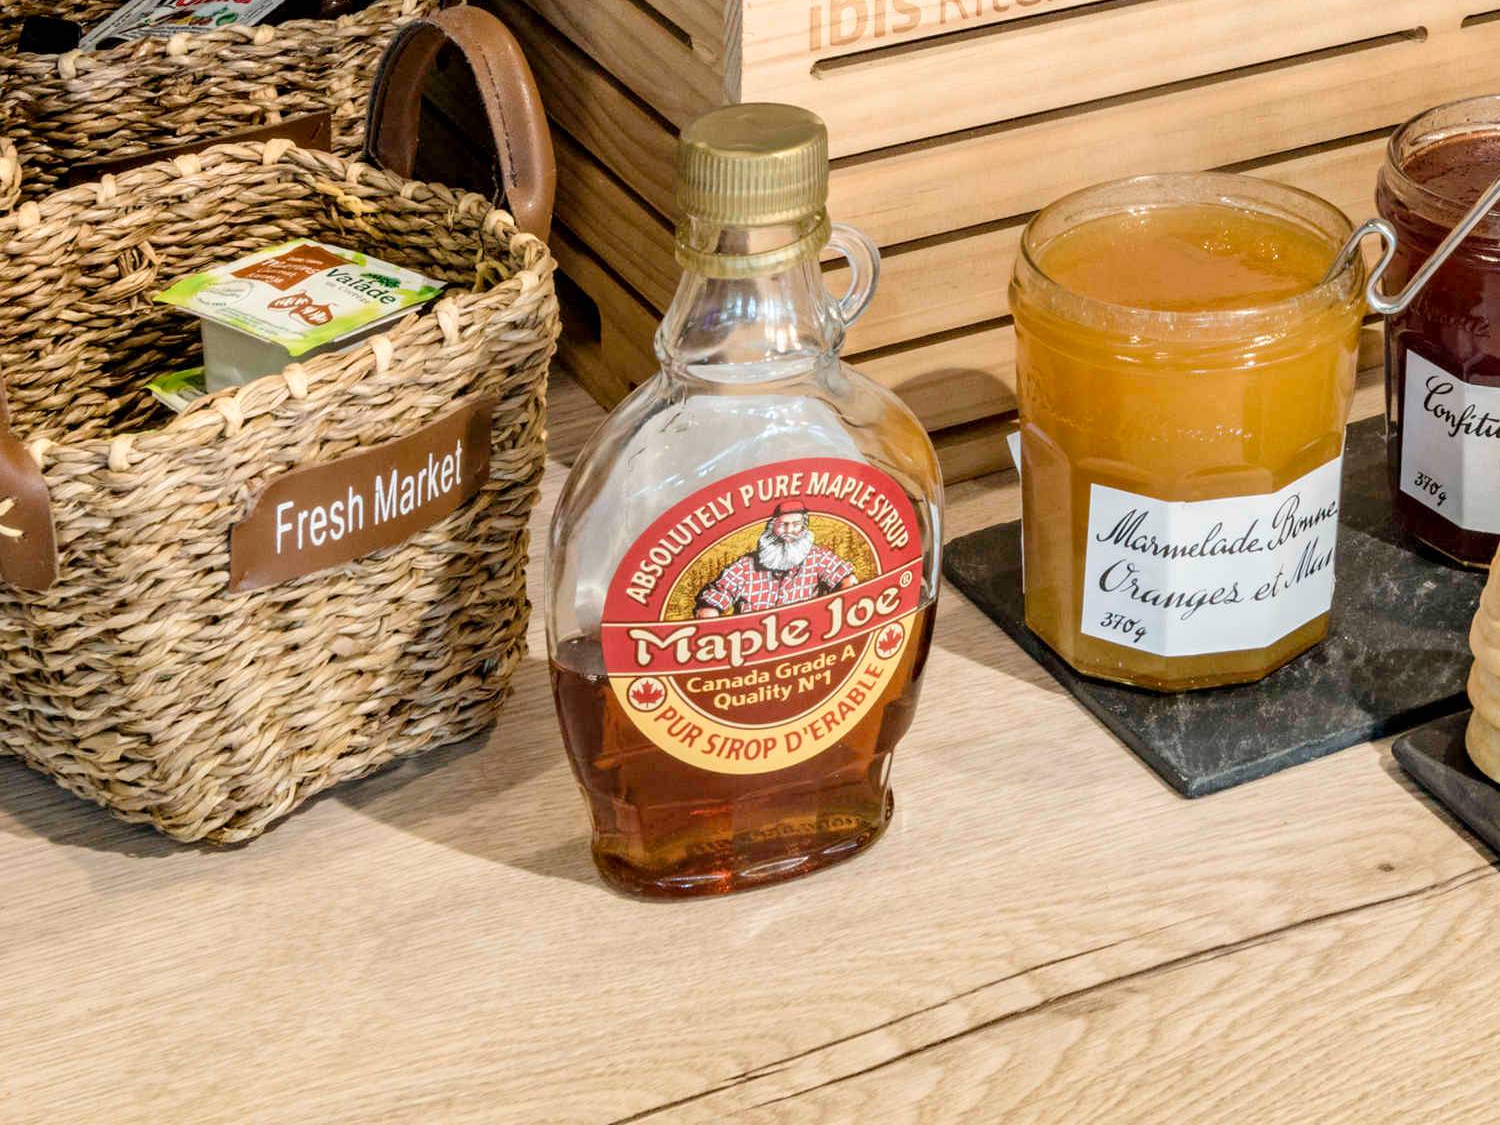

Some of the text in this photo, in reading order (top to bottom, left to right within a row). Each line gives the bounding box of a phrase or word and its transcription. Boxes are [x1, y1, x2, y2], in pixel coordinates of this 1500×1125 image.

[275, 438, 463, 555] Fresh Market
[1096, 493, 1338, 560] Marmelade Bonne
[625, 472, 911, 605] ABSOLUTELY PURE MAPLE SYRUP
[1099, 558, 1243, 621] Oranges
[1252, 571, 1283, 603] et
[629, 586, 901, 668] Maple Joe
[685, 644, 857, 695] Canada Grade A
[713, 685, 792, 711] Quality
[653, 663, 886, 761] PUR SIROP D'ERABLE
